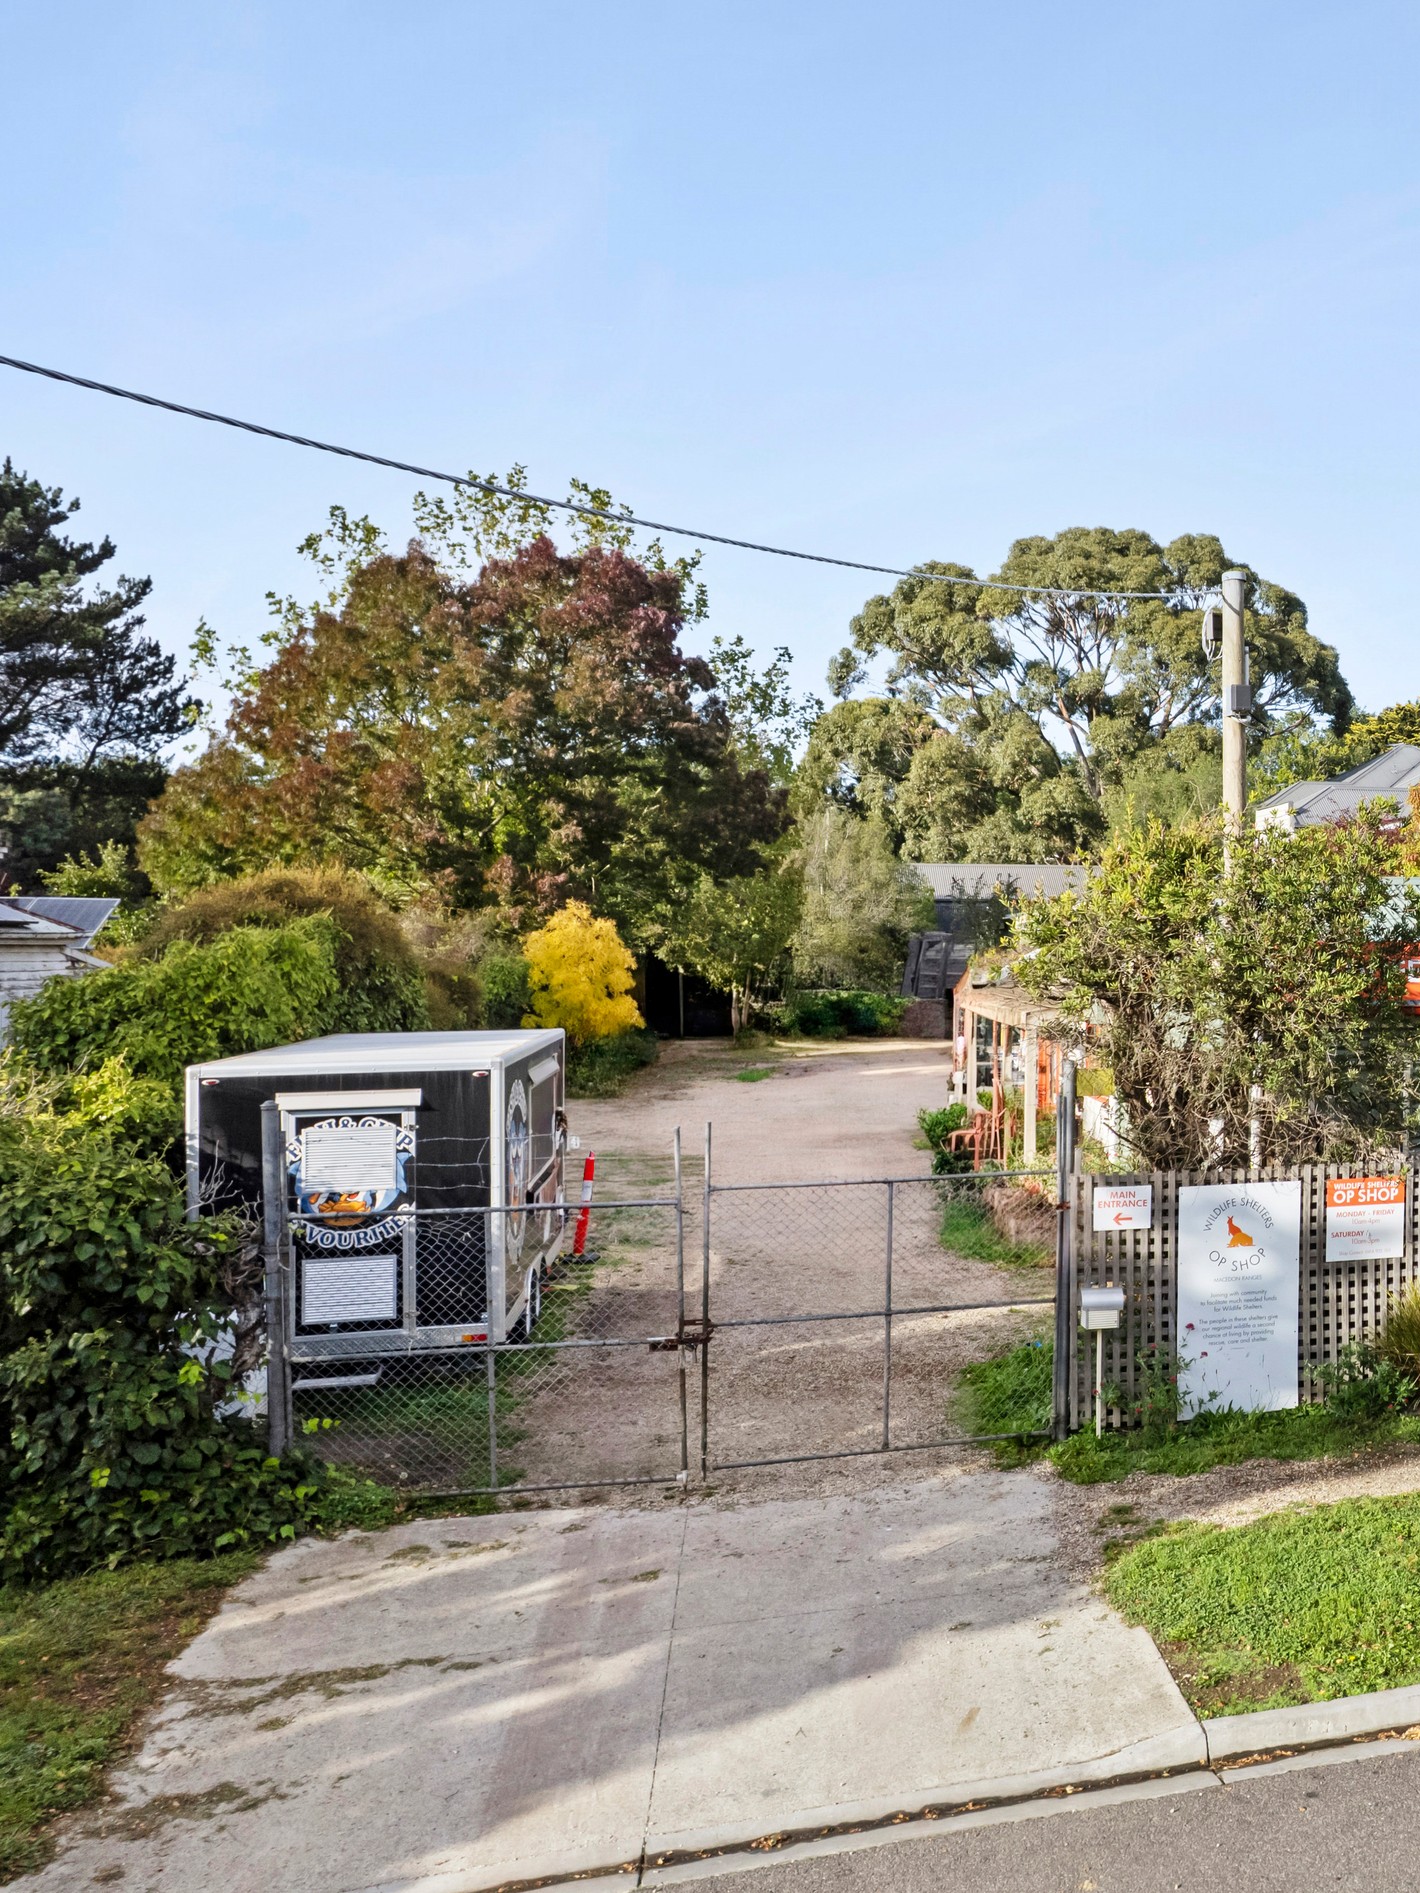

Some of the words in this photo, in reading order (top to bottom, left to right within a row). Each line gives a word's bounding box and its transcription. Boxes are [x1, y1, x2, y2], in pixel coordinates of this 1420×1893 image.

[1334, 1182, 1365, 1190] WILDLIFE
[1110, 1191, 1136, 1199] MAIN
[1333, 1190, 1355, 1203] OP
[1358, 1188, 1399, 1202] SHOP
[1097, 1199, 1148, 1208] ENTRANCE
[1203, 1198, 1237, 1232] WILDLIFE
[1240, 1197, 1274, 1229] SHELTERS
[1336, 1210, 1366, 1218] MONDAY
[1331, 1230, 1365, 1239] SATURDAY
[1209, 1250, 1227, 1266] OP
[1231, 1248, 1266, 1272] SHOP
